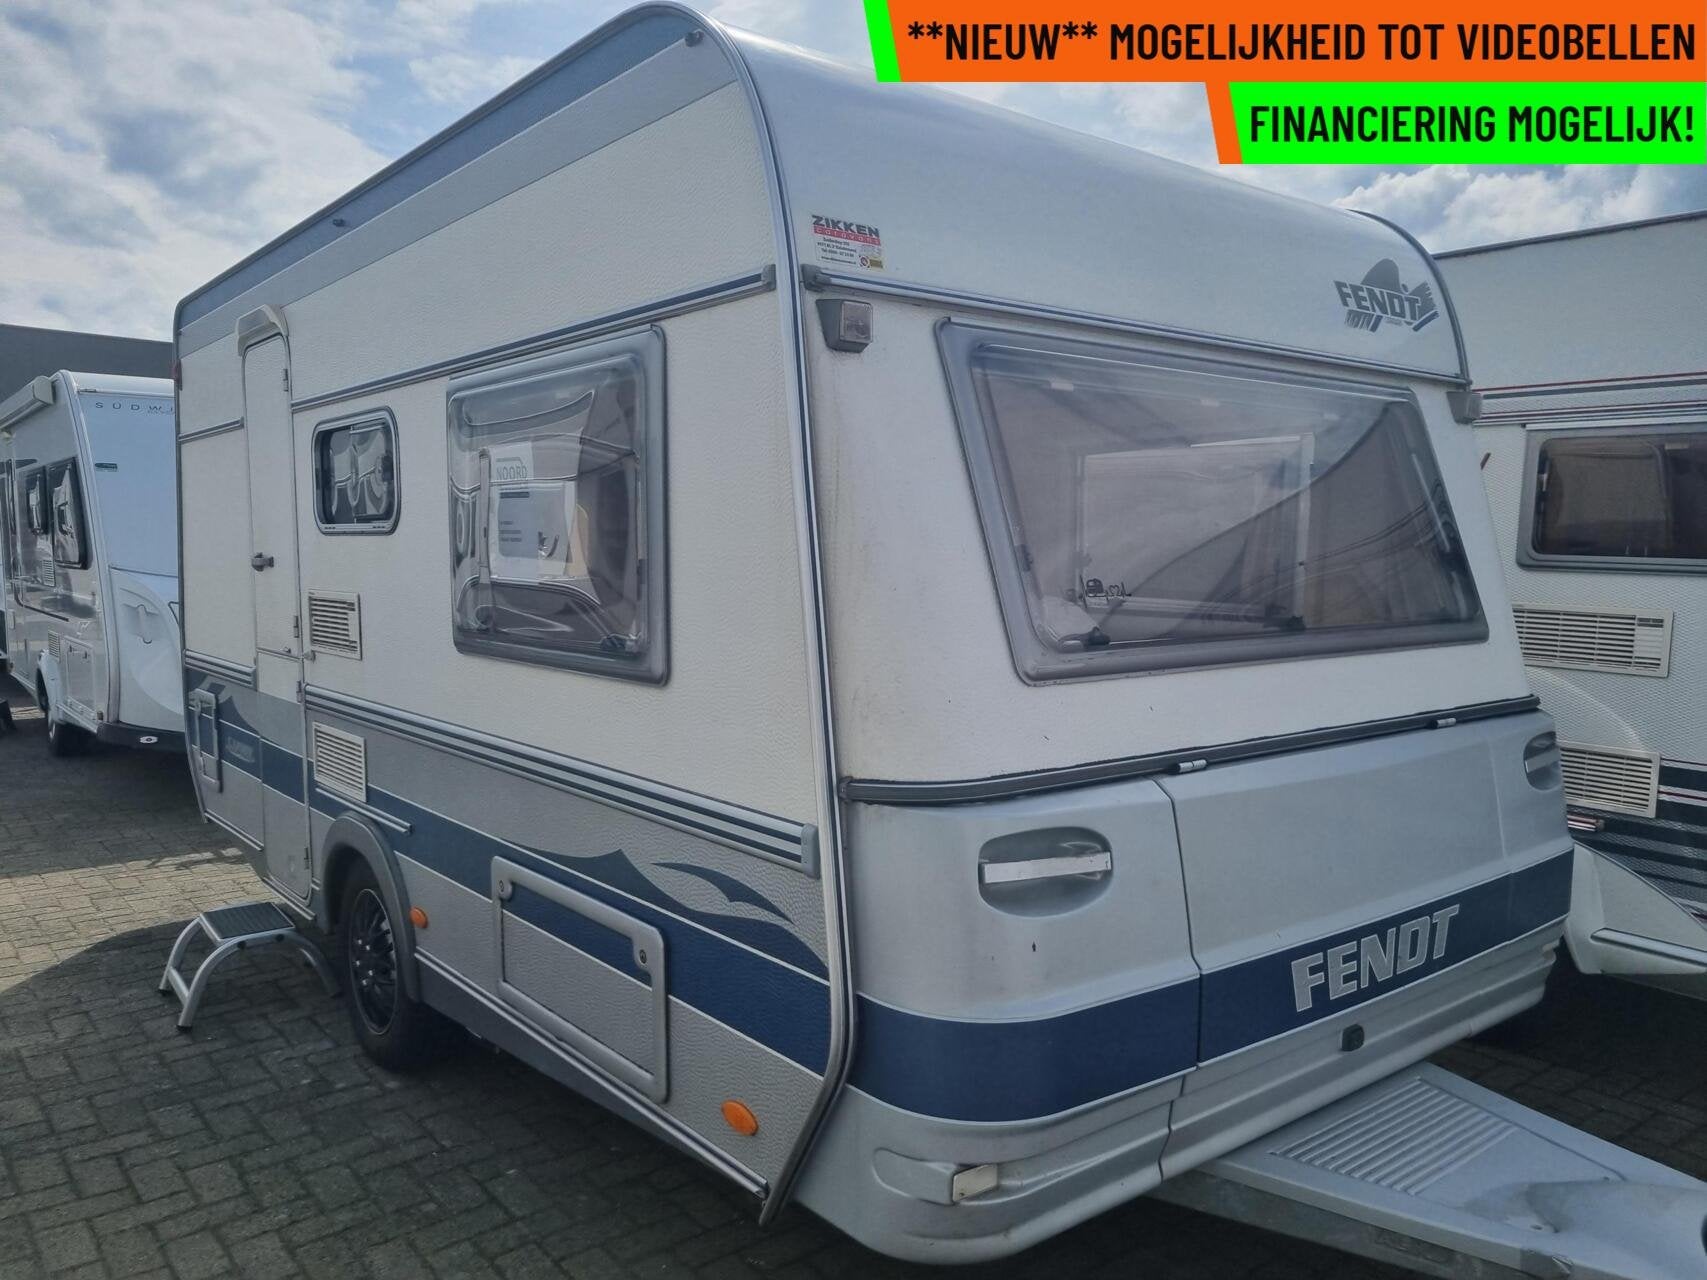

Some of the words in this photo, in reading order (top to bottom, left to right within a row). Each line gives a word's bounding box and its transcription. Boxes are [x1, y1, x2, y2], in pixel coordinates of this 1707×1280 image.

[811, 214, 880, 238] ZIKKEN
[1333, 280, 1420, 322] FENDT
[1291, 903, 1460, 1013] FENDT
